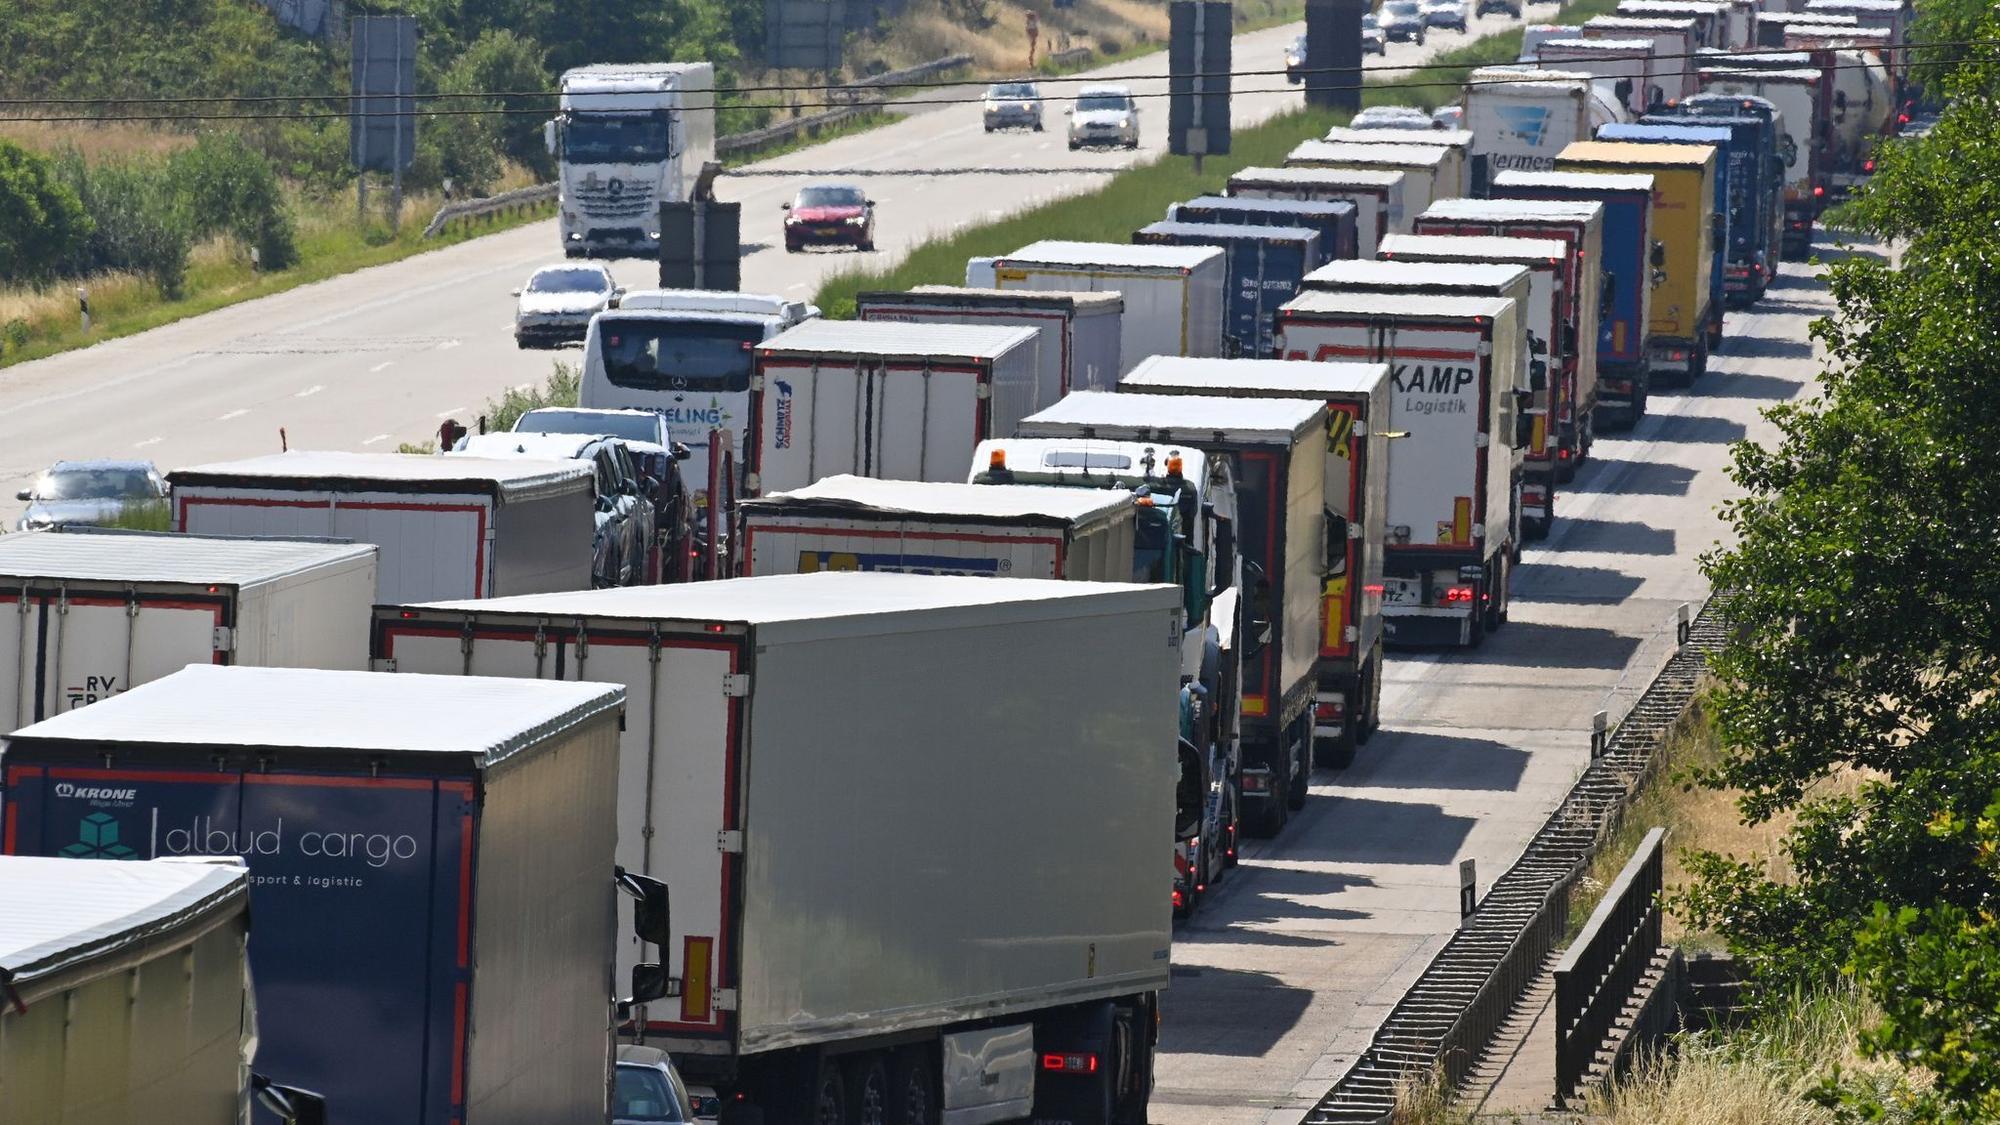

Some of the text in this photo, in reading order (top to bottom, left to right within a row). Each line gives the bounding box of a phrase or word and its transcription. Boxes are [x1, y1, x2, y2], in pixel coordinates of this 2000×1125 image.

[1391, 365, 1474, 394] KAMP
[1405, 399, 1467, 415] Logistik
[775, 398, 785, 449] SCHMITZ
[86, 676, 116, 691] RV
[74, 787, 137, 799] KRONE
[166, 816, 417, 868] albud cargo
[293, 875, 302, 886] &
[308, 875, 363, 889] logistic
